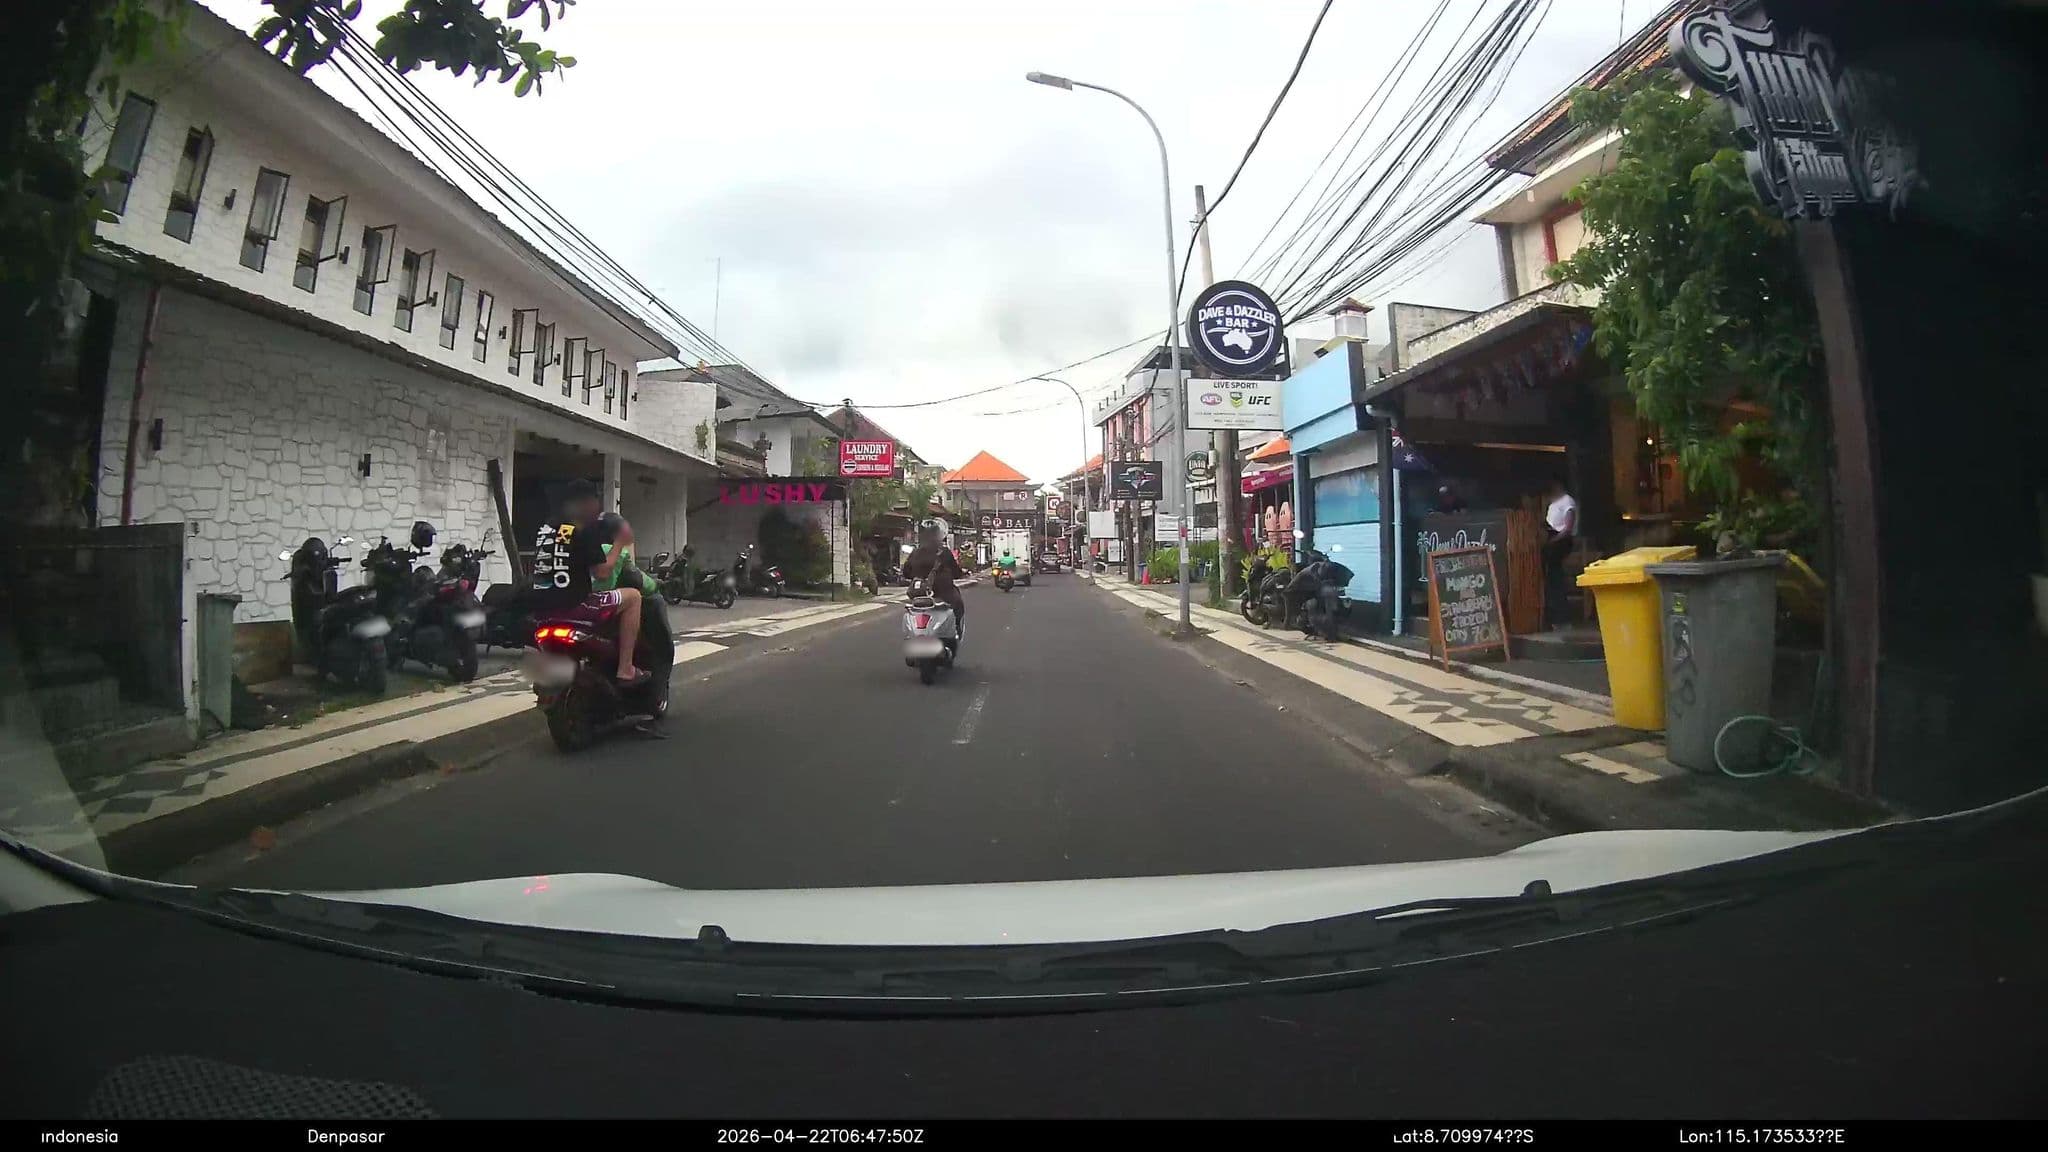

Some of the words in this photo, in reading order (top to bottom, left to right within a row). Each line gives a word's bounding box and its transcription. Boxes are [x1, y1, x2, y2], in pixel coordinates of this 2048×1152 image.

[1198, 305, 1224, 323] DAVE
[1225, 306, 1233, 317] &
[1233, 304, 1277, 327] DAZZLER
[1225, 318, 1250, 329] BAR
[1213, 381, 1230, 390] LIVE
[1231, 382, 1259, 390] SPORT!
[1248, 395, 1272, 406] UFC
[846, 444, 888, 455] LAUNDRY
[719, 483, 829, 507] LUSHY
[553, 544, 571, 589] OFF
